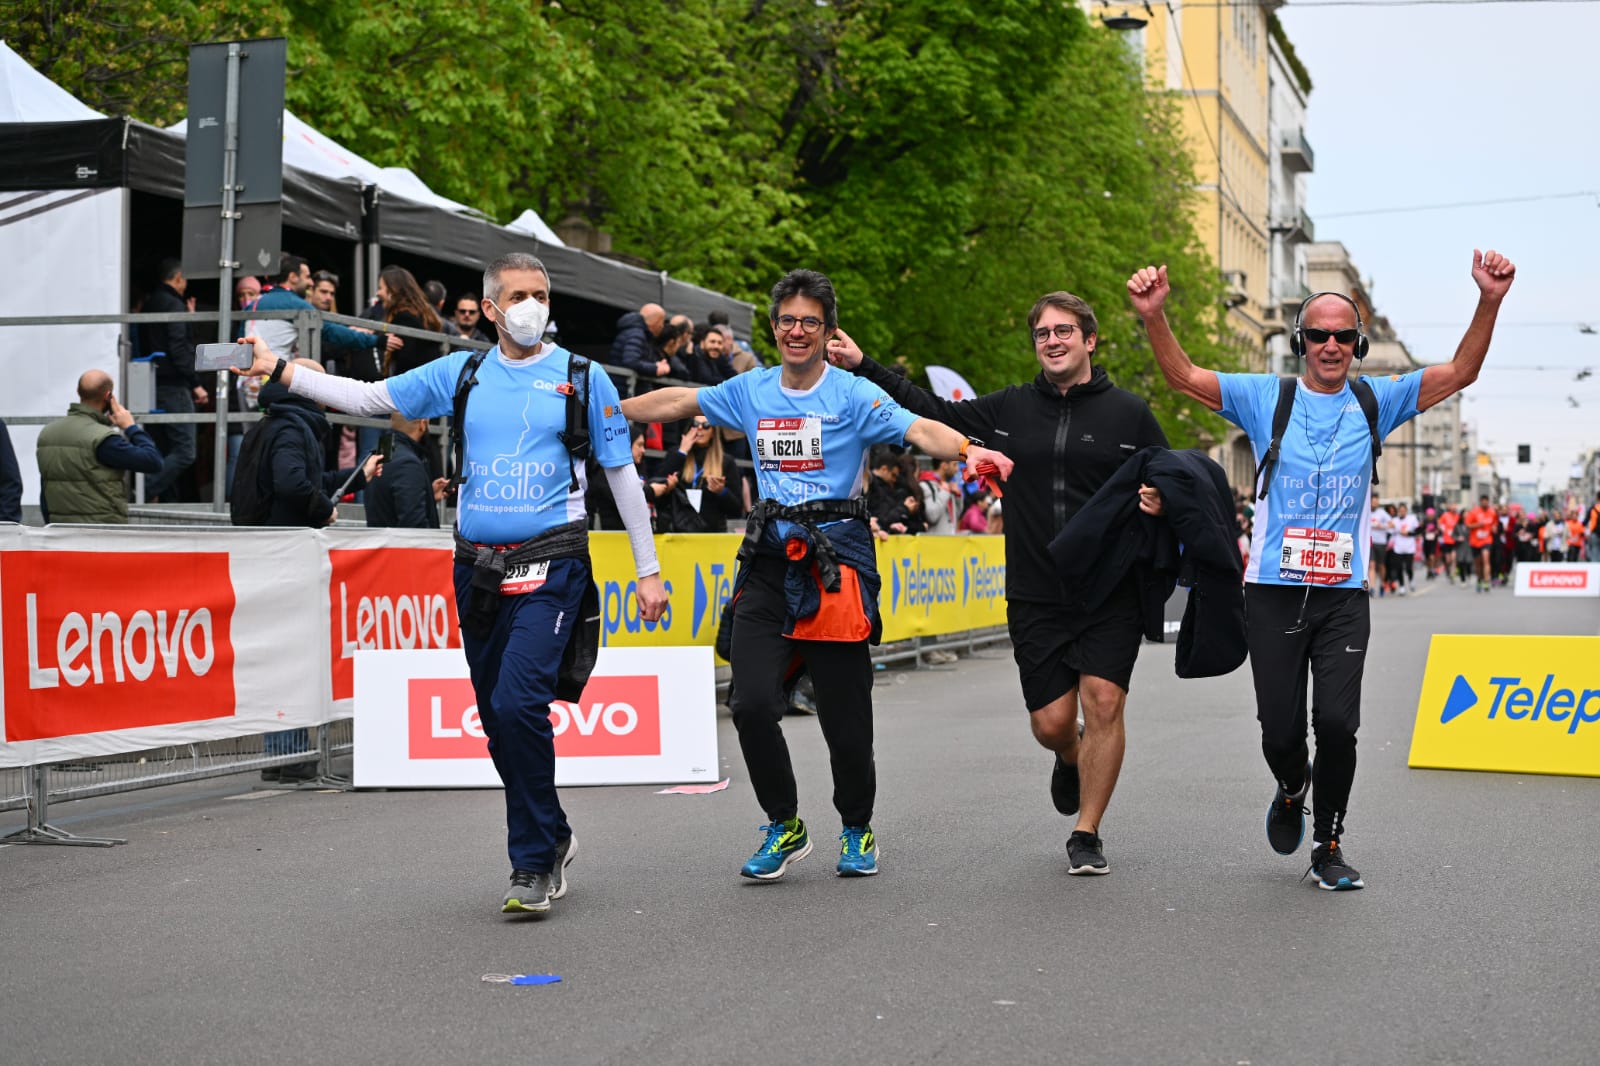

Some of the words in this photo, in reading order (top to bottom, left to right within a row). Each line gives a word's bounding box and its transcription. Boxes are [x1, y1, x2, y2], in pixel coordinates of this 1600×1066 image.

[771, 439, 804, 457] 1621A
[469, 461, 489, 476] Tra
[491, 457, 556, 482] Capo
[474, 487, 481, 498] e
[483, 479, 544, 500] Collo
[761, 479, 777, 494] Tra
[779, 478, 830, 500] Capo
[1280, 475, 1304, 489] Tra
[1308, 471, 1362, 493] Capo
[1287, 498, 1297, 509] e
[1299, 491, 1355, 510] Collo
[1300, 549, 1336, 569] 1621D
[902, 553, 956, 618] Telepass
[1533, 573, 1584, 586] Lenovo
[340, 581, 449, 659] Lenovo
[26, 592, 215, 690] Lenovo
[1487, 673, 1600, 735] Telep
[430, 695, 638, 738] Leovo
